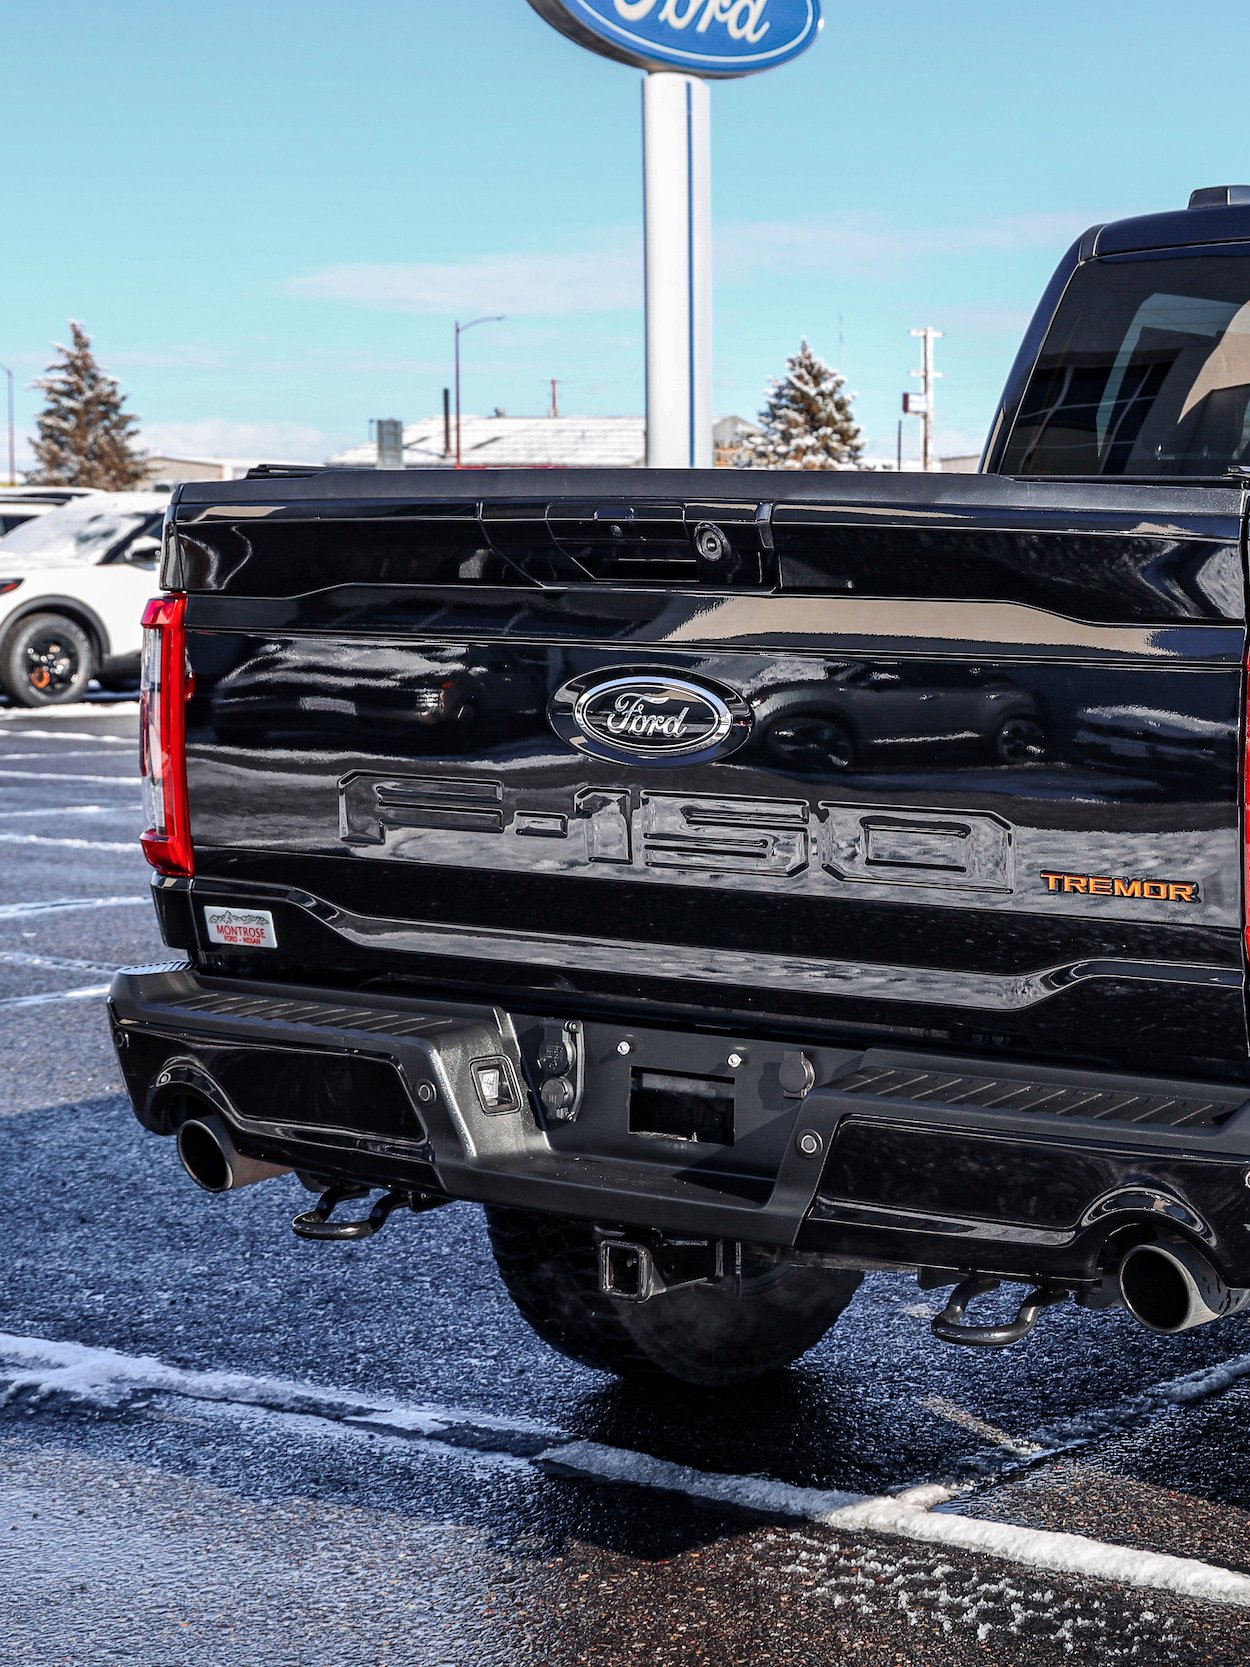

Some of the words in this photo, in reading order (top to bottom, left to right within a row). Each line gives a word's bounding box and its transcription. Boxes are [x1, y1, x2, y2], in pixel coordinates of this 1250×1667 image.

[606, 692, 690, 738] Ford
[338, 769, 1014, 894] F-150
[1040, 869, 1201, 903] TREMOR
[216, 924, 267, 939] MONTROSE
[223, 935, 238, 943] FORD
[242, 937, 262, 945] NISSAN
